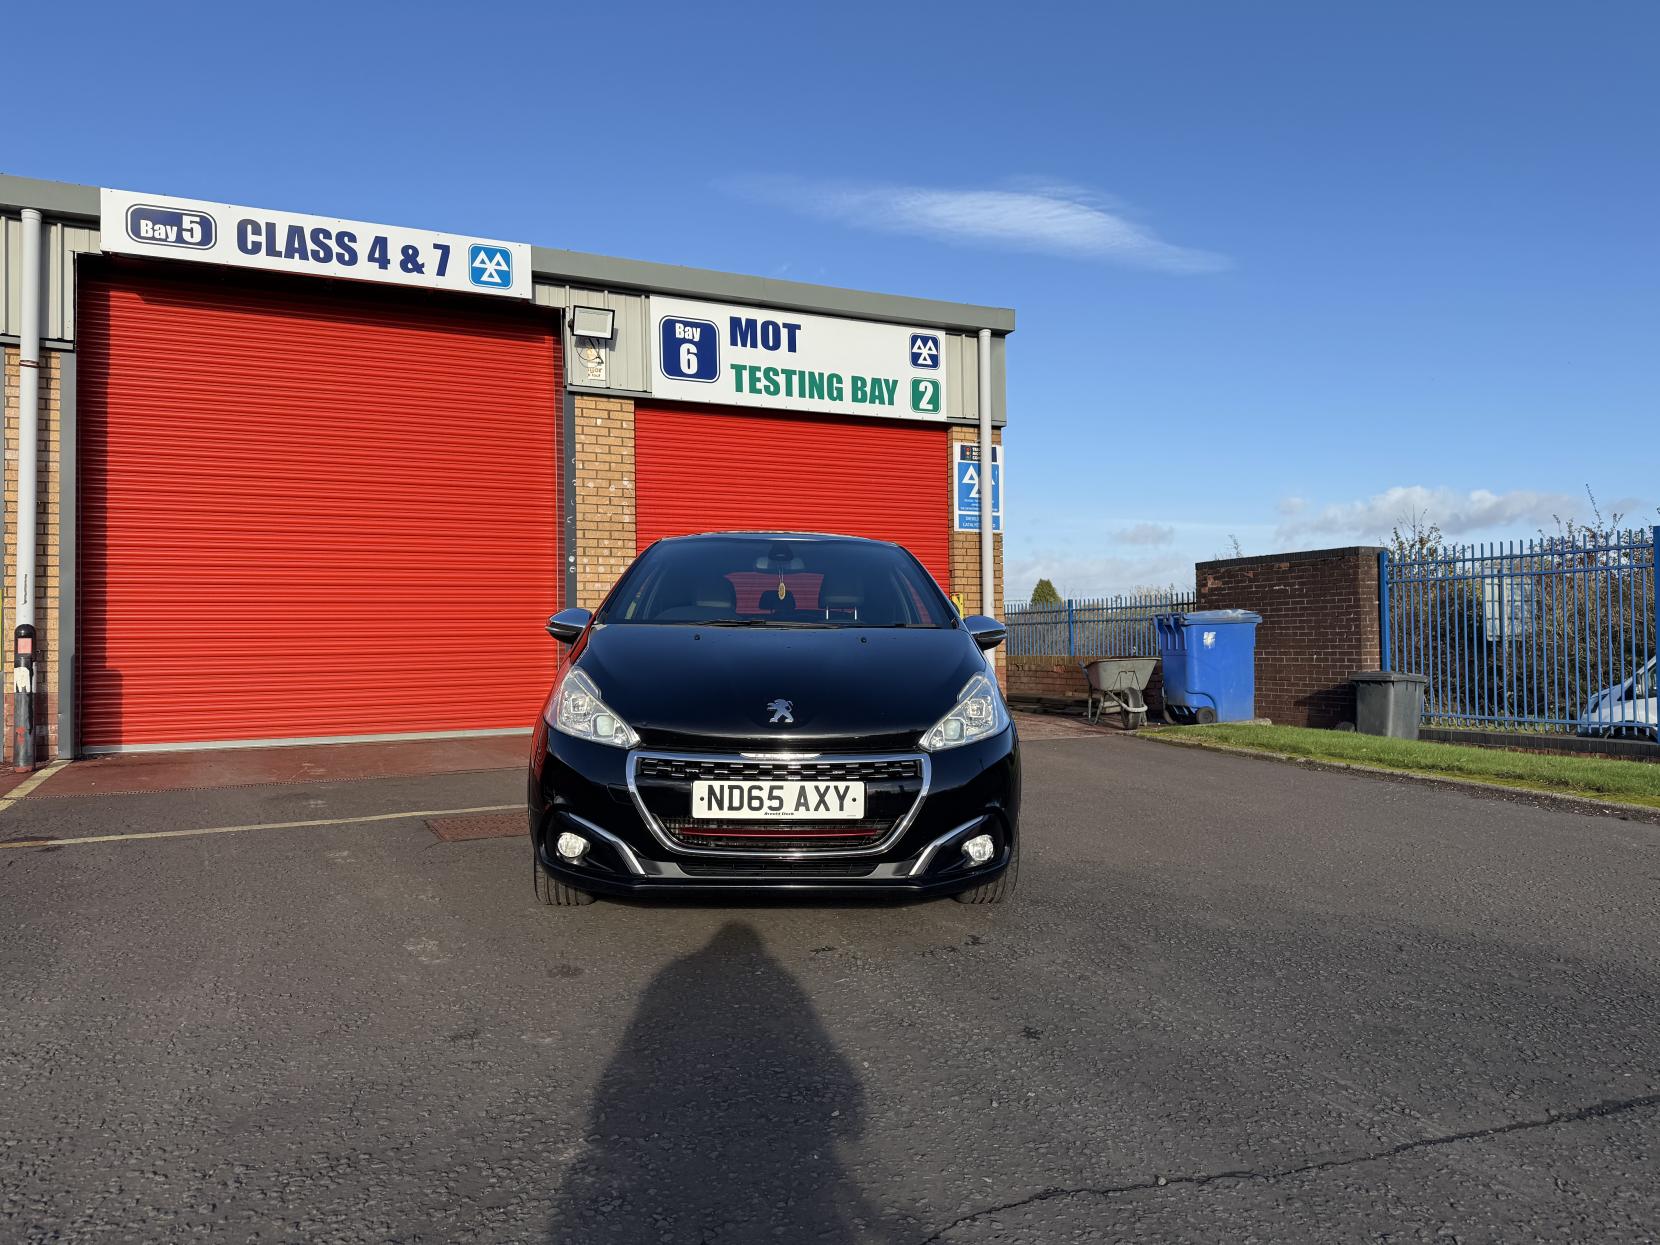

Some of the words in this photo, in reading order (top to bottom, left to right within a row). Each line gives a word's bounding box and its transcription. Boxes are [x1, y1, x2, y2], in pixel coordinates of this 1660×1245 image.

[140, 219, 178, 242] Bay
[181, 215, 202, 243] 5
[236, 218, 359, 267] CLASS
[367, 235, 391, 270] 4
[399, 244, 425, 275] &
[432, 242, 451, 277] 7
[675, 323, 701, 342] Bay
[729, 316, 802, 353] MOT
[679, 343, 698, 375] 6
[730, 363, 844, 402] TESTING
[851, 375, 899, 406] BAY
[918, 381, 934, 410] 2
[707, 784, 785, 812] ND65
[793, 785, 851, 812] AXY
